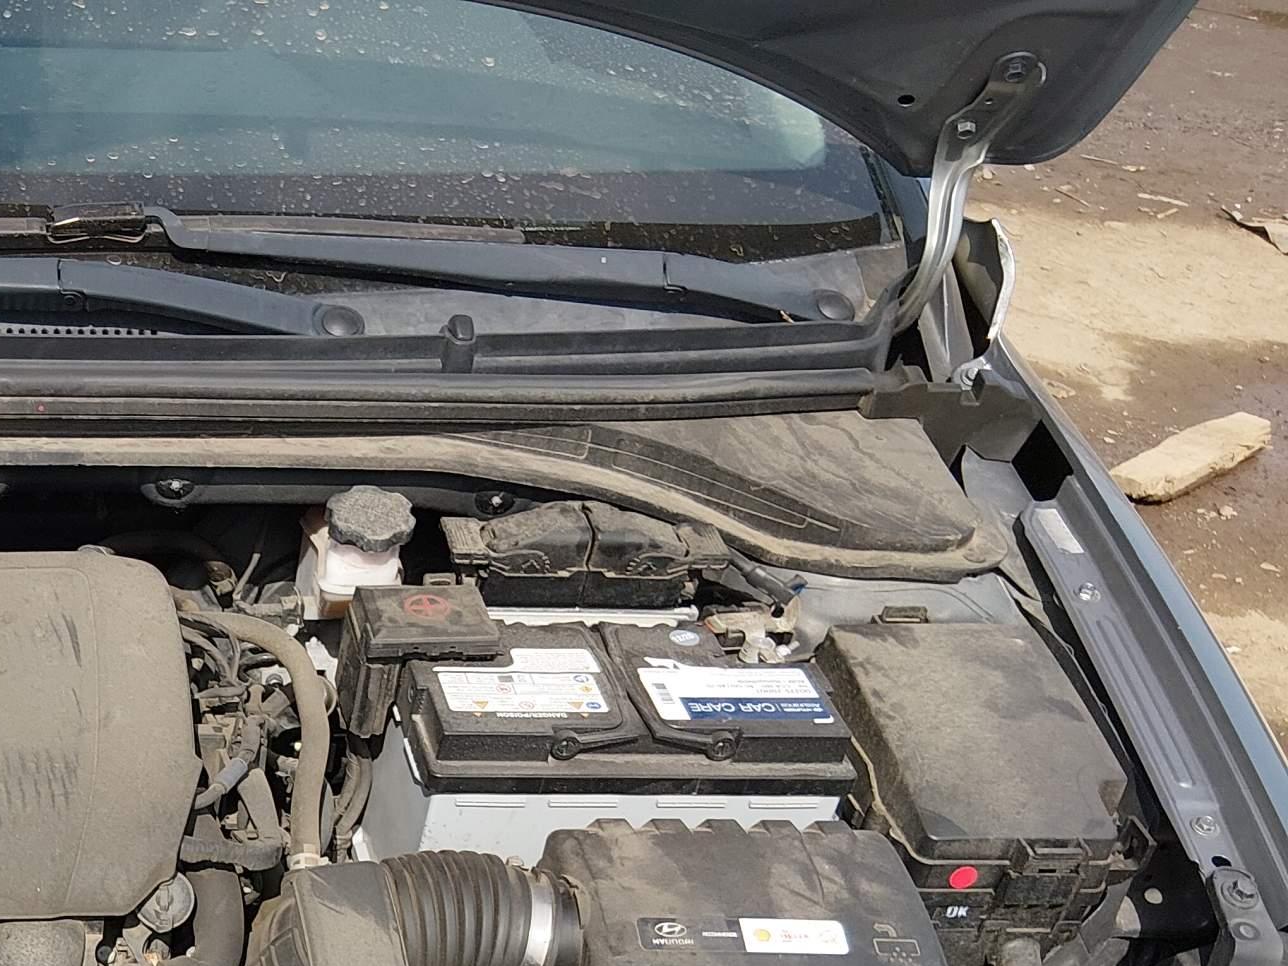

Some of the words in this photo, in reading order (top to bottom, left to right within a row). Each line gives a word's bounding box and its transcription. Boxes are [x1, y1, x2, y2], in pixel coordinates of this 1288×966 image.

[688, 702, 735, 713] CARE
[739, 702, 775, 713] CAR
[945, 905, 969, 918] OK
